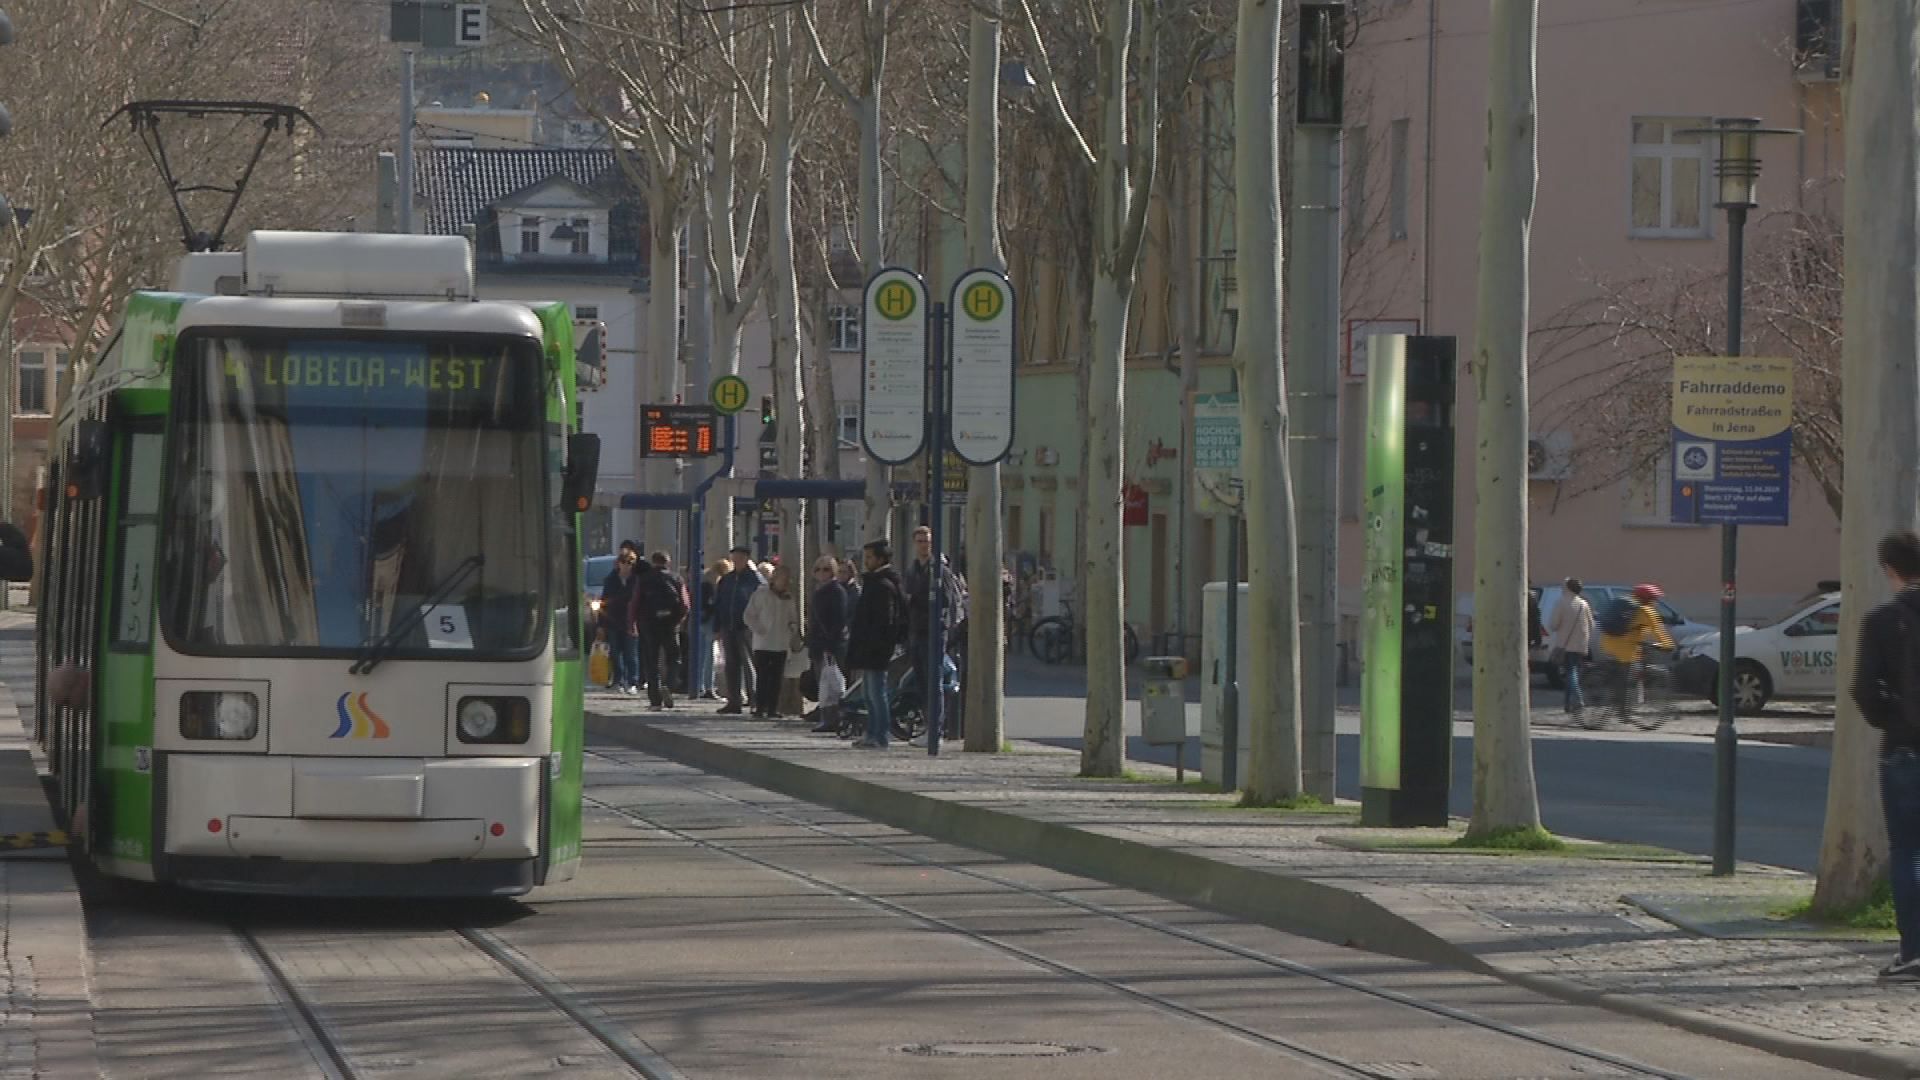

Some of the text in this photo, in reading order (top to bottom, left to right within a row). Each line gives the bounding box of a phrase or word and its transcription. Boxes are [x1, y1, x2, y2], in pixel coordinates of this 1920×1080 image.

[461, 9, 481, 41] E
[887, 288, 905, 312] H
[974, 289, 992, 312] H
[263, 354, 485, 390] LOBEDA-WEST
[722, 383, 738, 405] H
[1680, 380, 1786, 395] Fahrraddemo
[1686, 405, 1782, 417] Fahrradstraßen
[1727, 422, 1756, 433] Jena
[439, 615, 456, 634] 5
